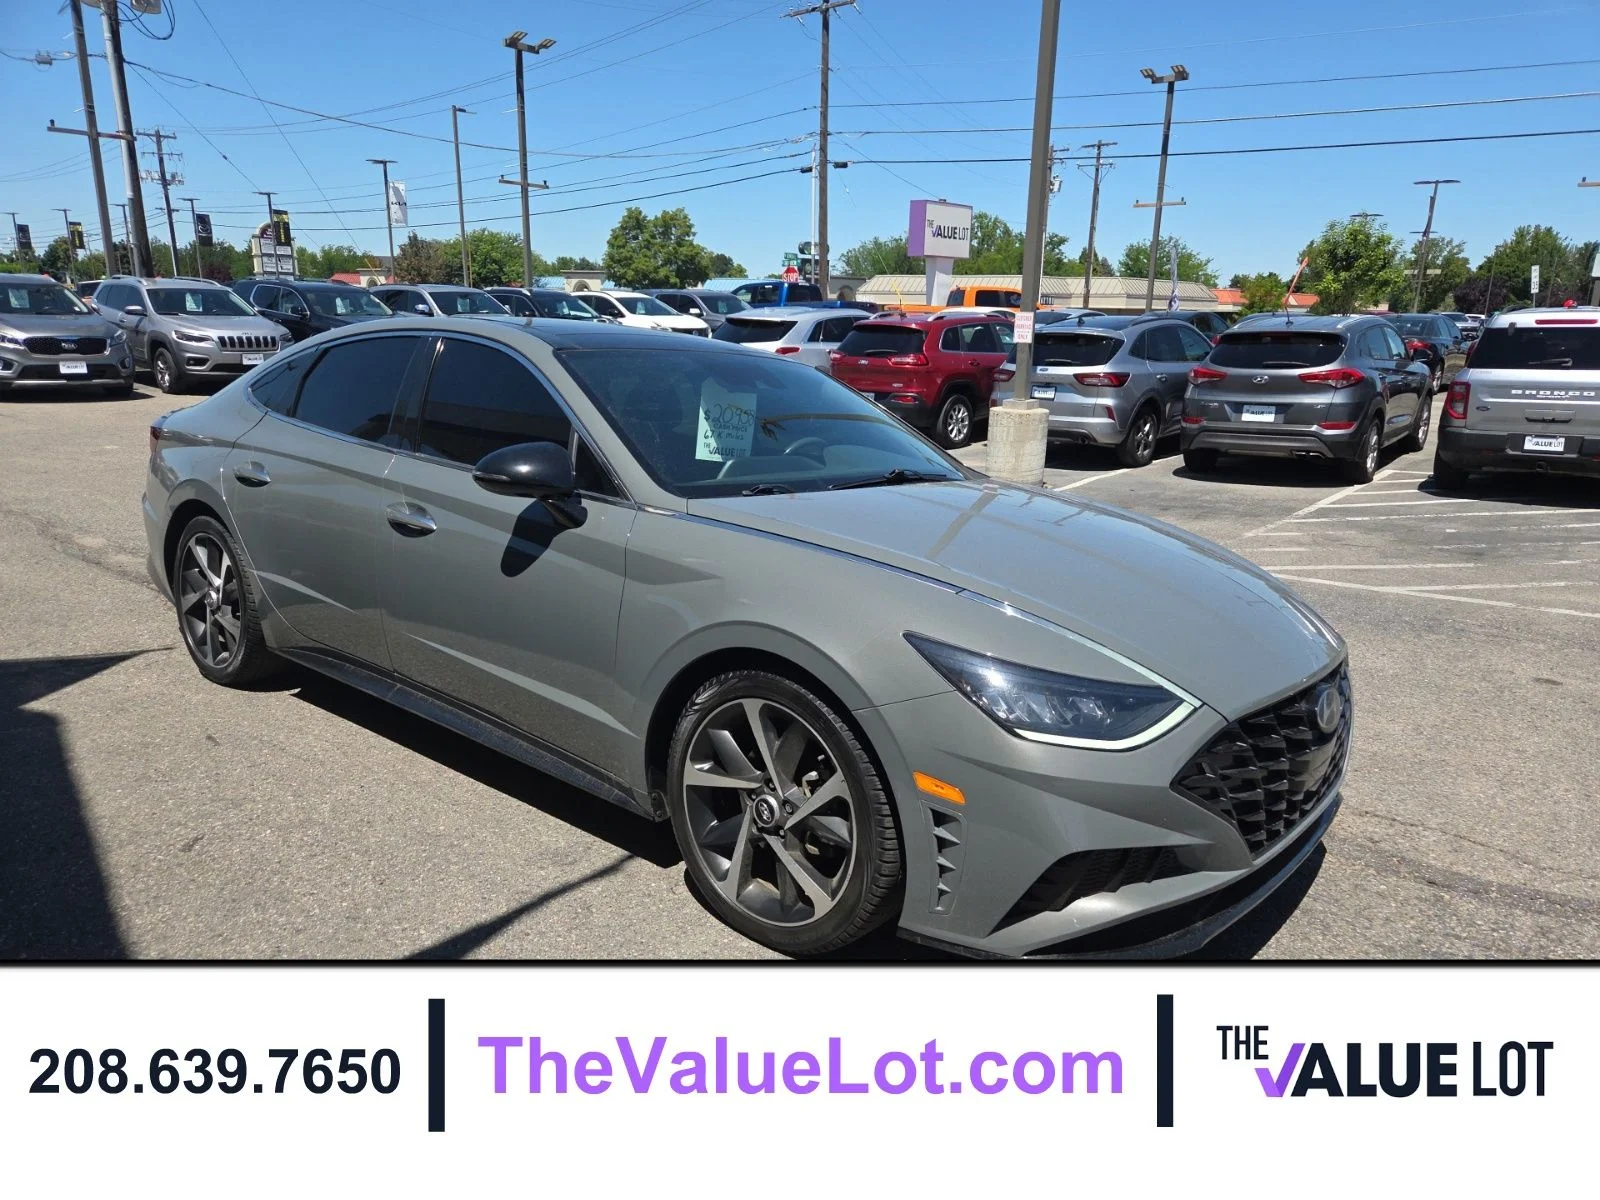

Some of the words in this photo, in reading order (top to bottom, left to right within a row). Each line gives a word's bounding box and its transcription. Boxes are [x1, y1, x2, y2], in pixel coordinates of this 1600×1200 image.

[927, 219, 935, 228] THE
[932, 225, 958, 240] VALUE
[958, 227, 969, 240] LOT
[783, 272, 799, 282] STOP
[1511, 389, 1596, 397] BRONCO
[709, 446, 736, 457] VALUE
